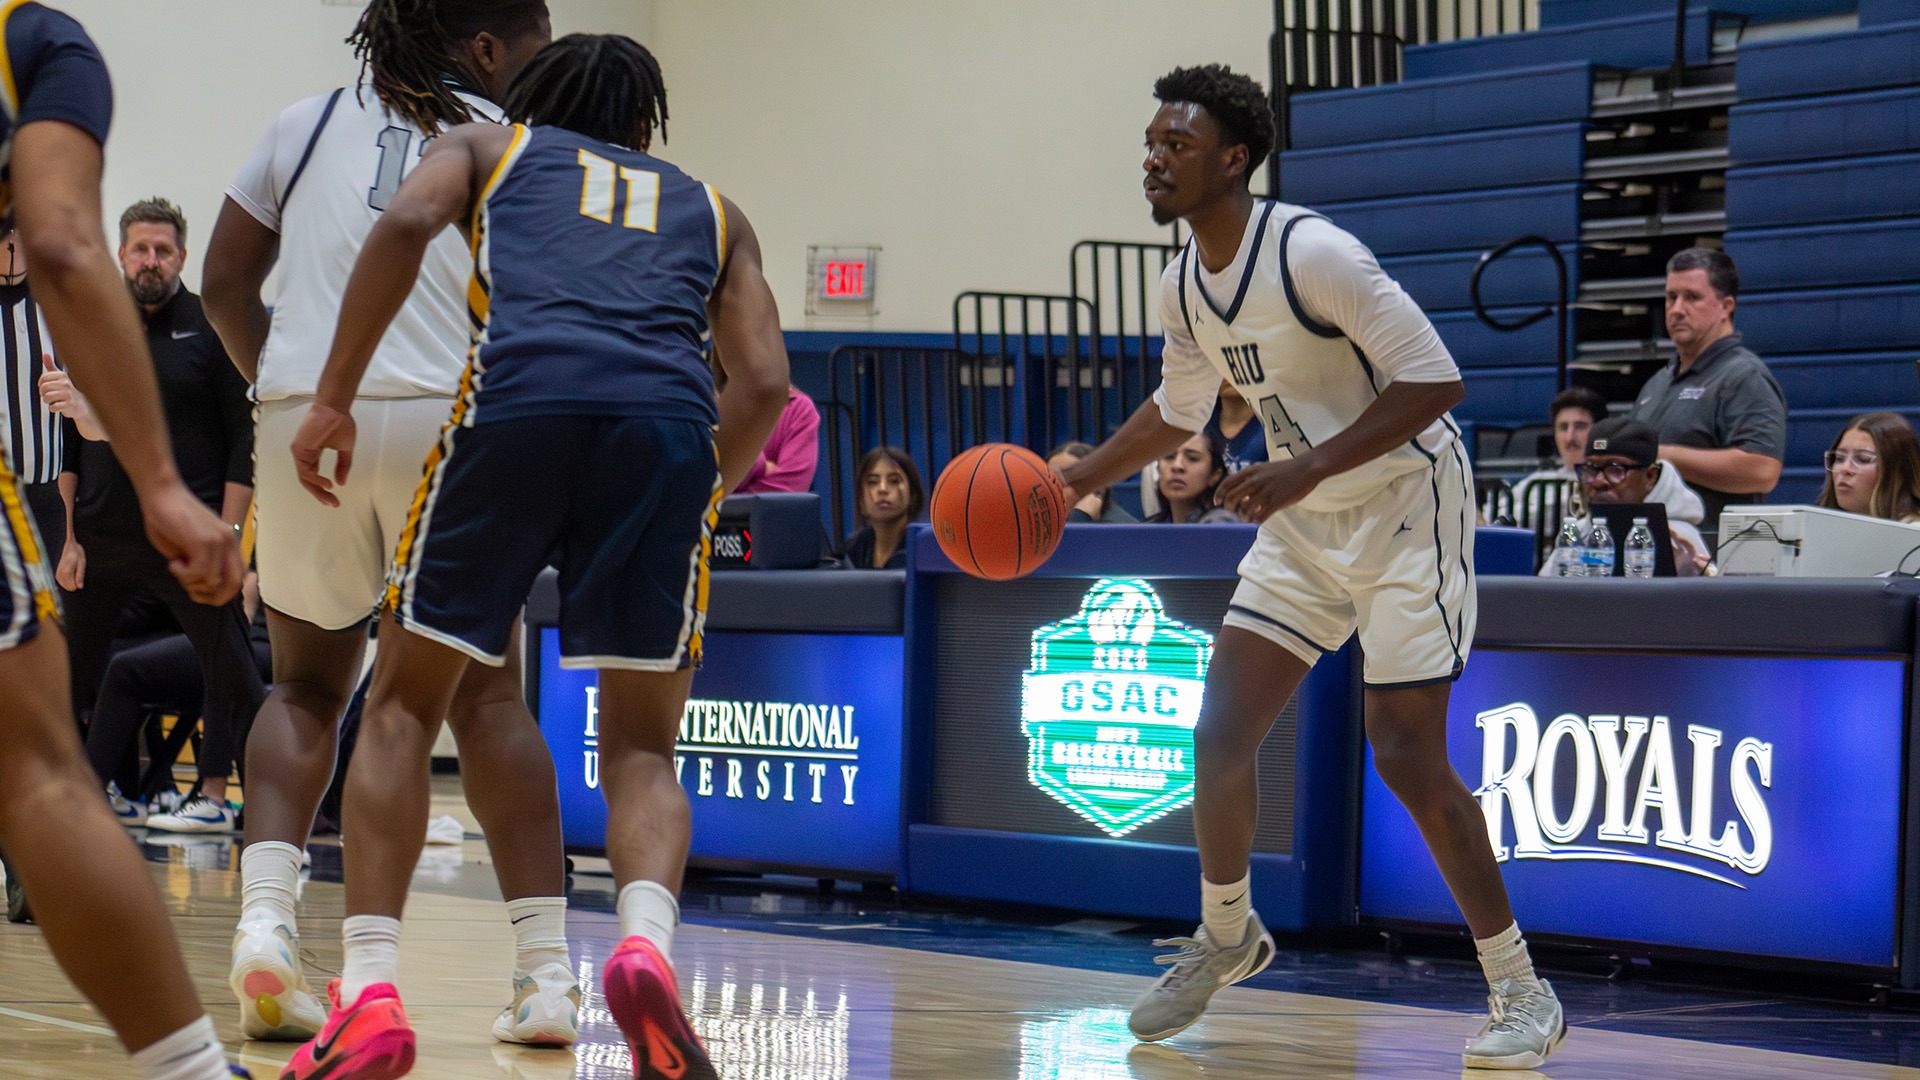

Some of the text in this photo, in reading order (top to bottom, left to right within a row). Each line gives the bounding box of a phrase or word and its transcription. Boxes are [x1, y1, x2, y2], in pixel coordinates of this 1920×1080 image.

[368, 125, 435, 211] 1
[577, 148, 660, 233] 11
[826, 261, 864, 296] EXIT
[1220, 342, 1265, 386] HIU
[714, 535, 744, 557] POSS.
[675, 698, 859, 750] NTERNATIONAL
[1061, 680, 1179, 717] GSAC
[584, 751, 859, 806] UVERSITY
[1473, 702, 1773, 875] ROYALS
